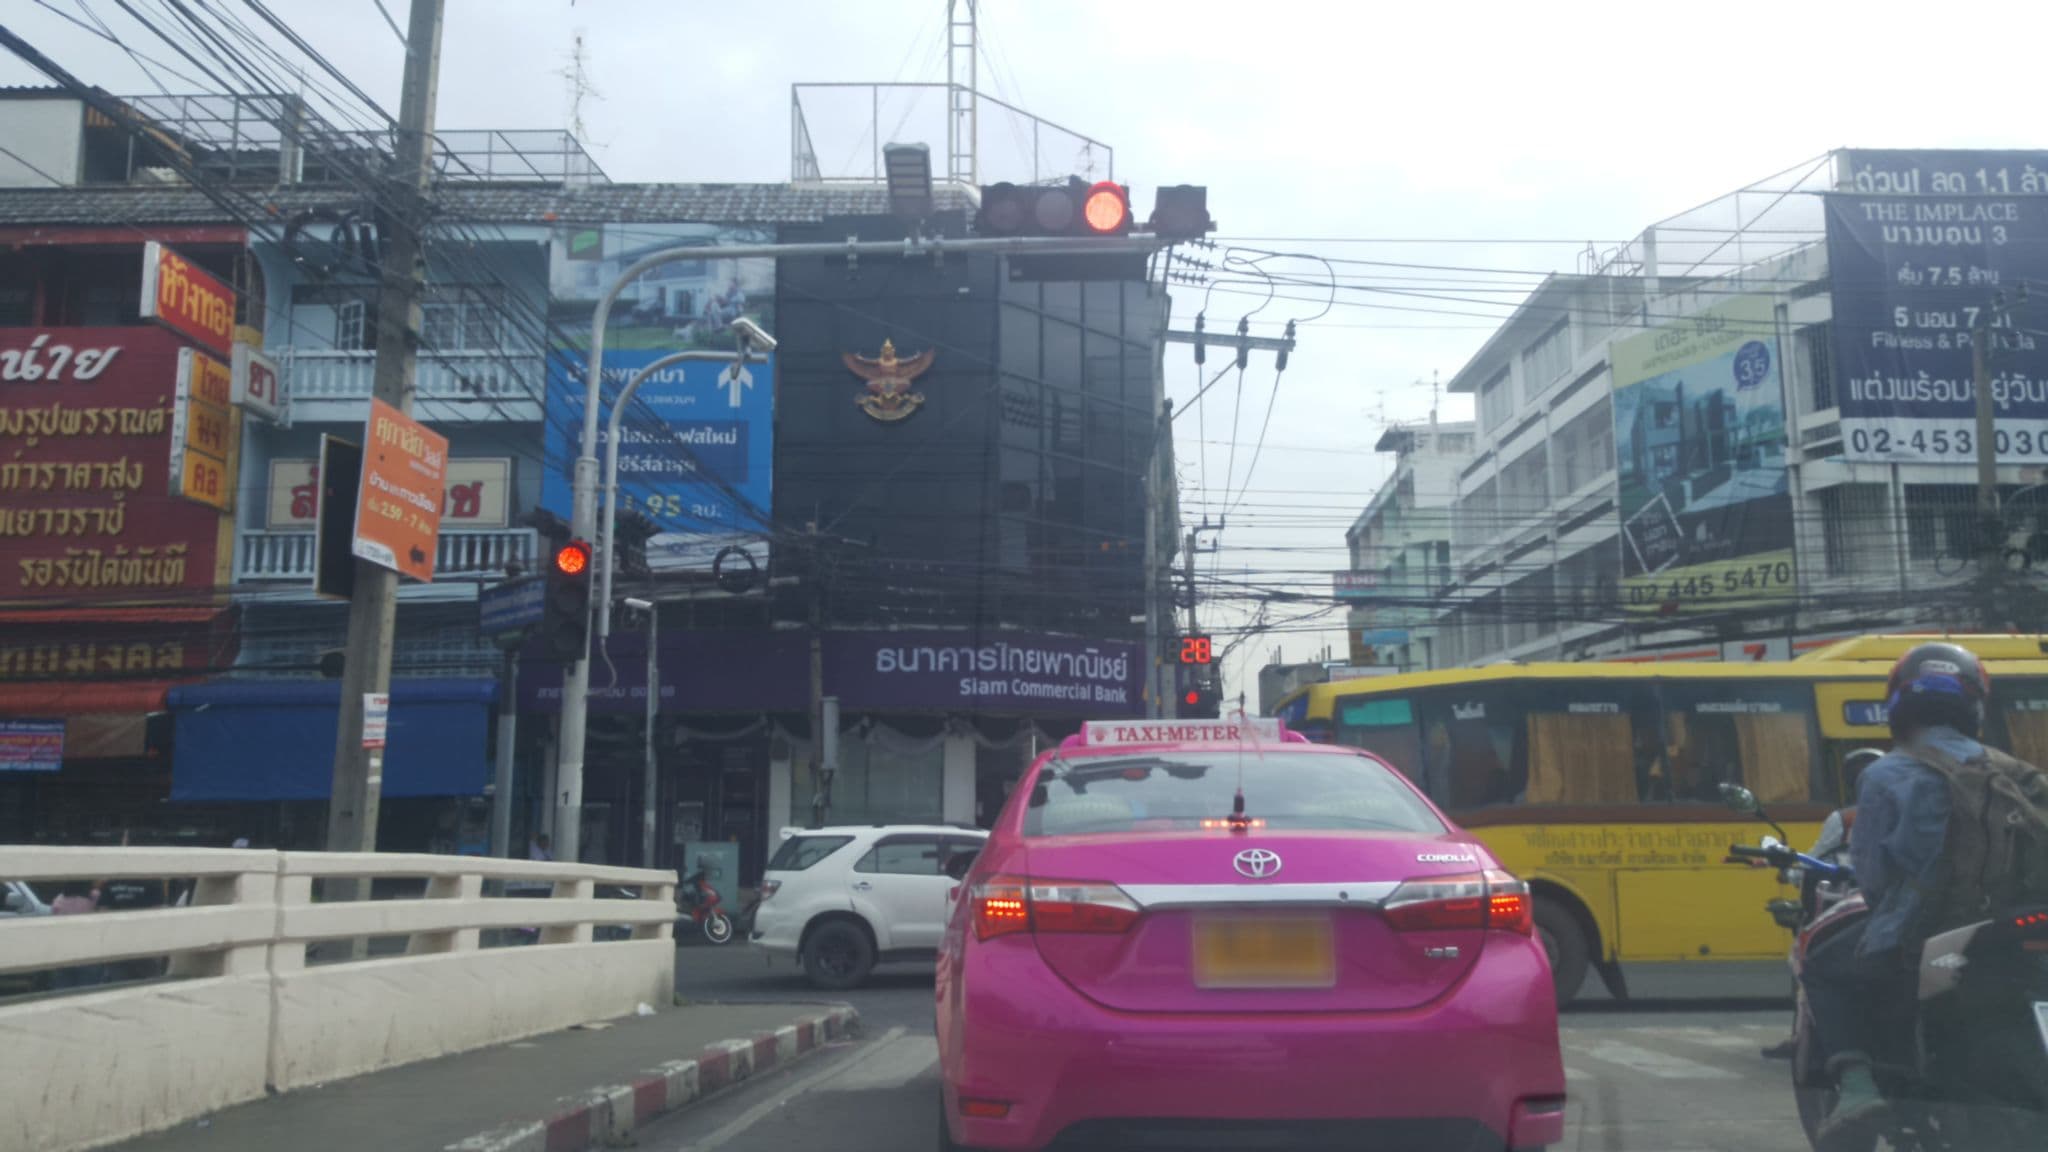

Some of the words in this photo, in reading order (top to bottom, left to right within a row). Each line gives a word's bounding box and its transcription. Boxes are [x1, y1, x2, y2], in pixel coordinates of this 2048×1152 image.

[1931, 170, 1966, 194] ลด
[1976, 167, 2010, 194] 1.1
[1860, 202, 1909, 222] THE
[1914, 202, 2019, 223] IMPLACE
[1882, 225, 1982, 247] บางบอน
[1992, 225, 2008, 246] 3
[1927, 267, 1962, 286] 7.5
[1894, 306, 1909, 328] 5
[1915, 310, 1957, 329] นอน
[1963, 306, 1980, 328] 7
[1871, 332, 1933, 349] Fitness
[1937, 332, 1951, 349] &
[249, 360, 278, 406] ยา
[1851, 428, 2048, 454] 02-453030
[19, 543, 188, 587] รอรับได้ทันที
[1723, 561, 1791, 592] 5470
[876, 643, 1128, 681] ธนาคารไทยพาณิชย์
[1180, 637, 1211, 664] 28
[959, 678, 1008, 696] Siam
[1011, 679, 1091, 701] Commercial
[1095, 685, 1127, 703] Bank
[1114, 724, 1241, 742] TAXI-METER
[1416, 853, 1476, 863] COROLLA
